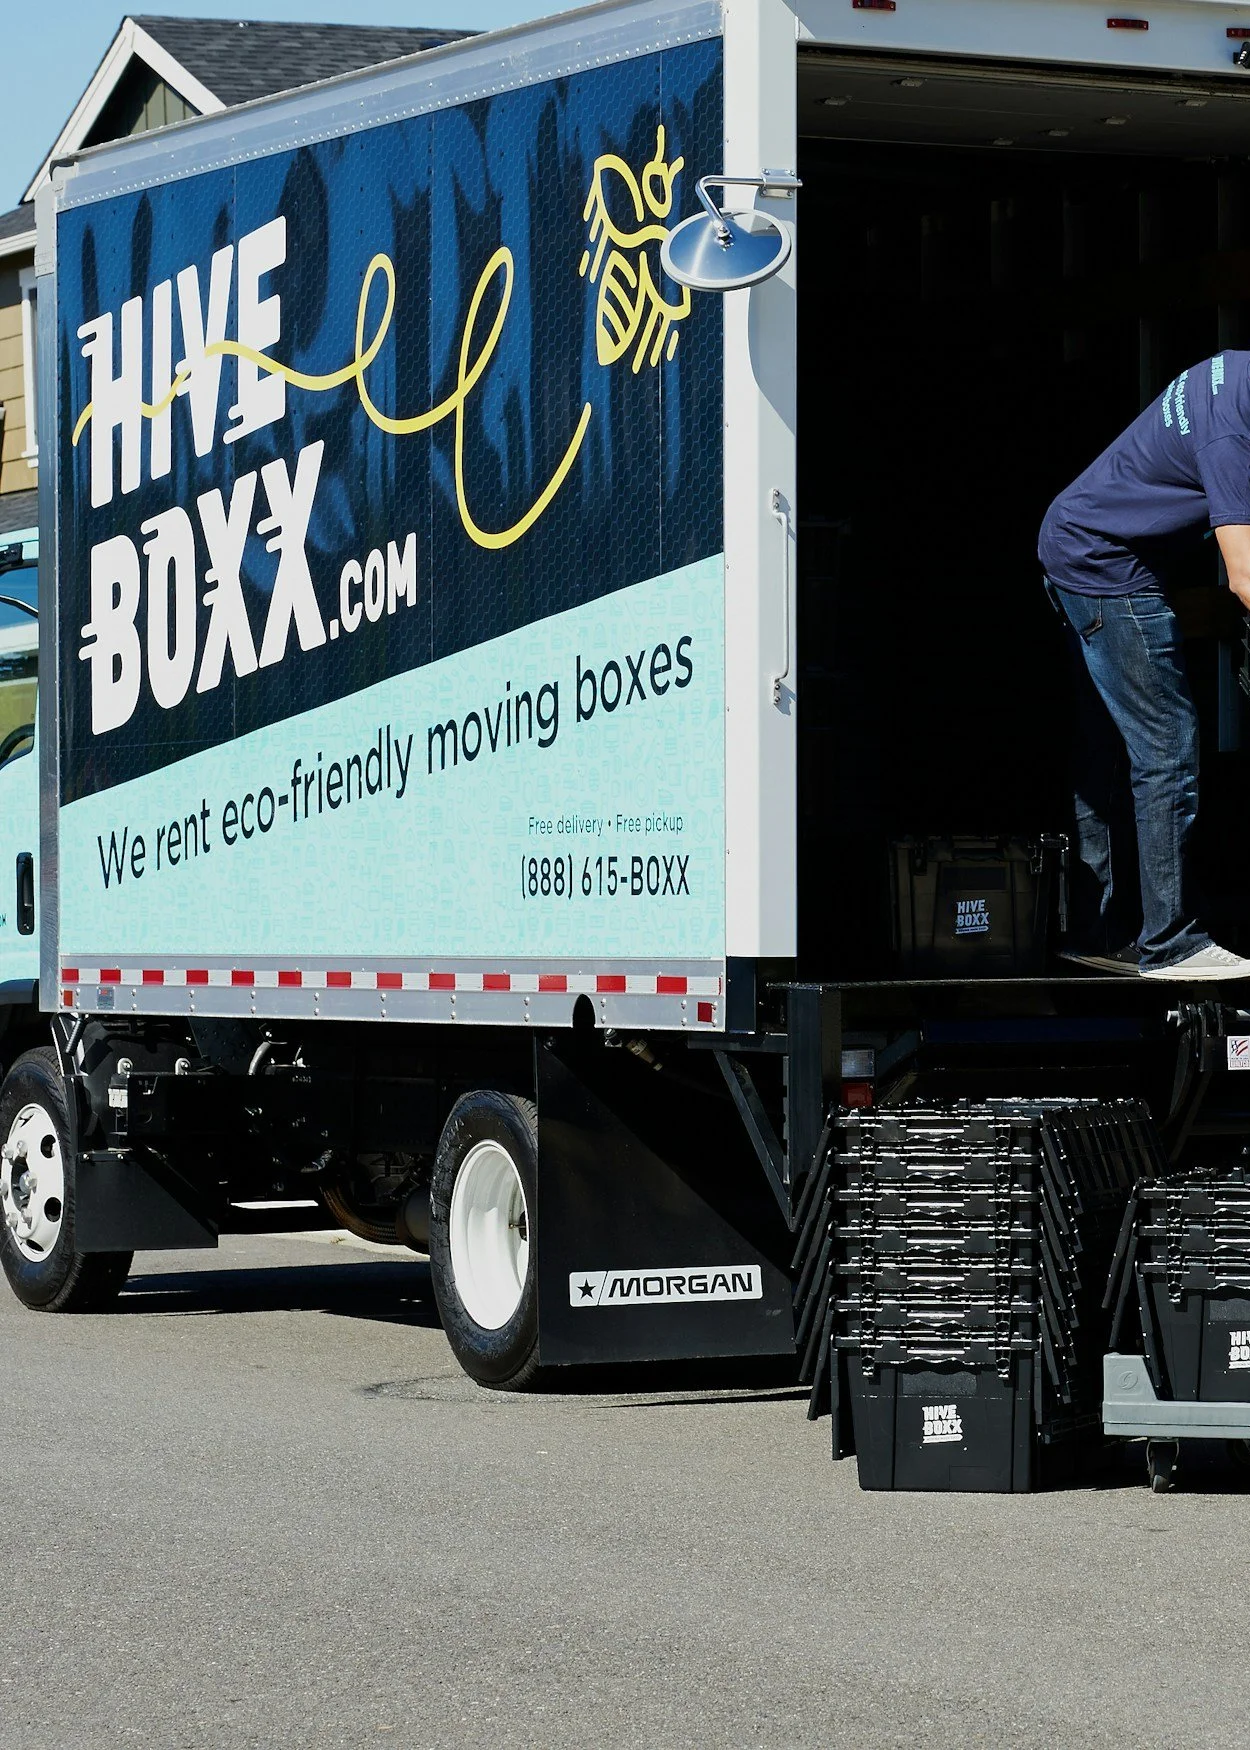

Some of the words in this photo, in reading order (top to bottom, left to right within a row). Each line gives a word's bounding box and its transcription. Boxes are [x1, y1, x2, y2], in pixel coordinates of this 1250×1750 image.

[77, 215, 286, 508] HIVE
[97, 826, 146, 889] We
[156, 799, 211, 871] rent
[222, 724, 413, 846] eco-friendly
[427, 680, 559, 775] moving
[576, 635, 693, 723] boxes
[528, 816, 553, 834] Free
[557, 814, 604, 837] delivery
[616, 814, 641, 833] Free
[645, 811, 684, 835] pickup
[521, 853, 573, 900] (888)
[581, 855, 690, 896] 615-BOXX
[955, 912, 989, 927] BOXX
[956, 899, 985, 914] HIVE
[608, 1272, 753, 1298] MORGAN
[922, 1404, 957, 1420] HIVE
[922, 1419, 963, 1435] BOXX
